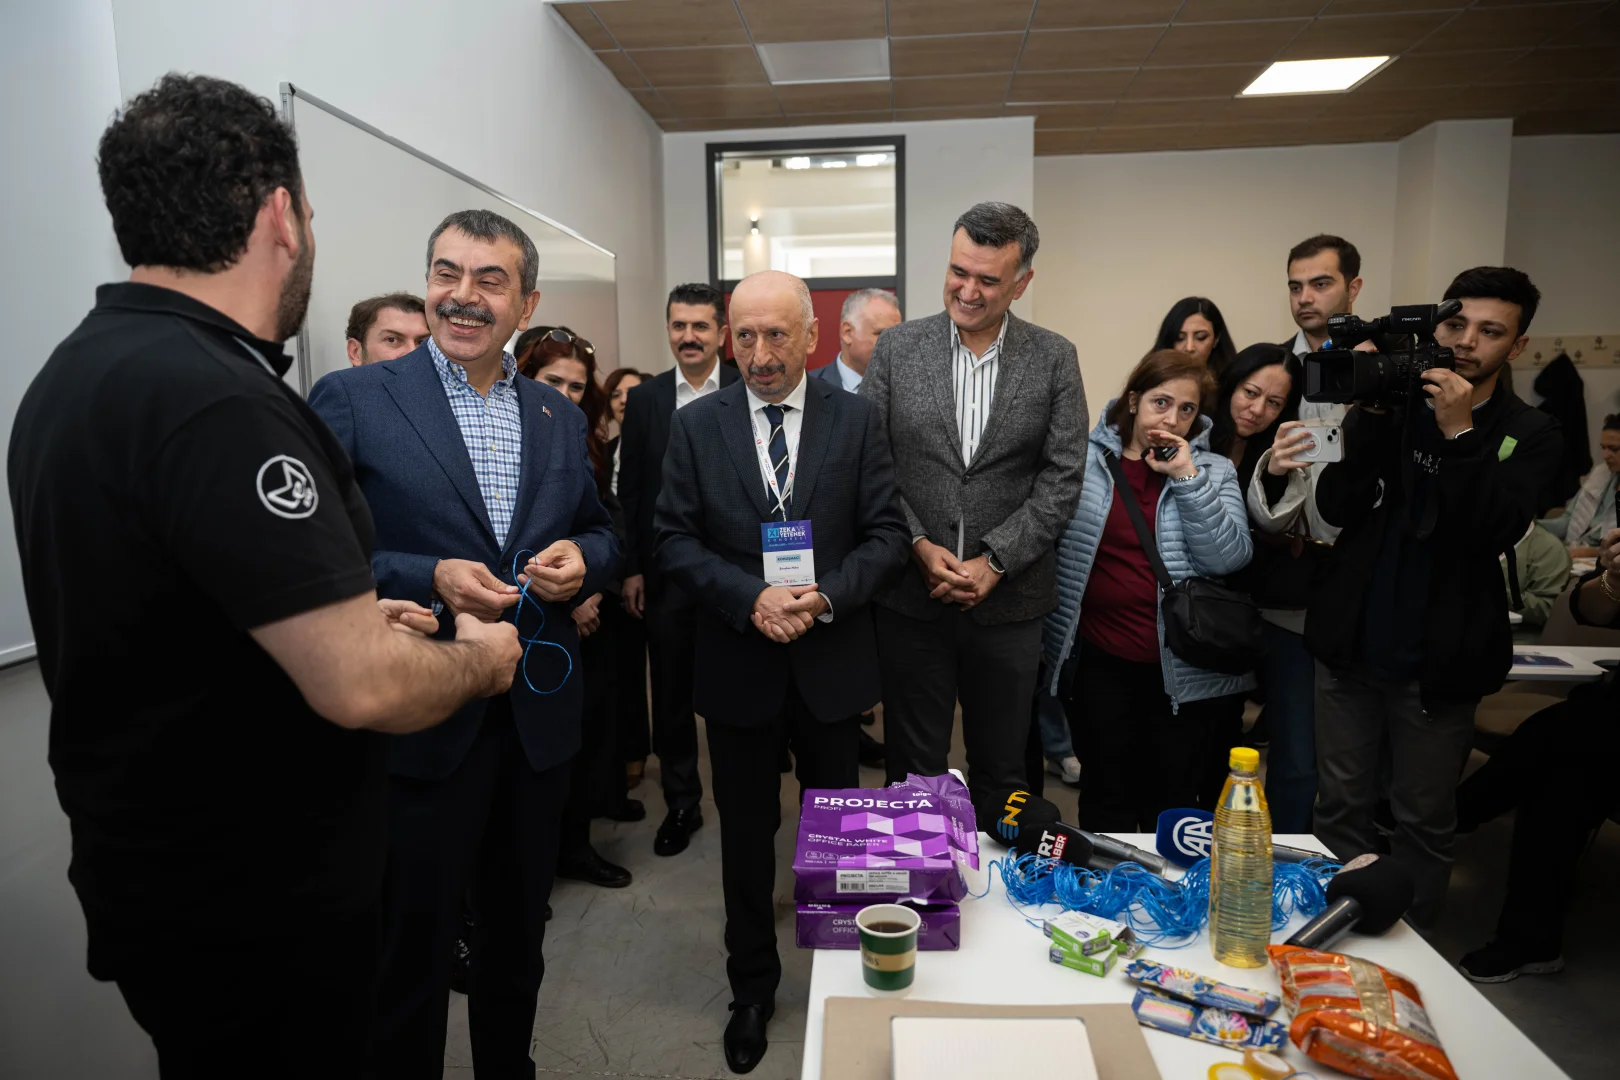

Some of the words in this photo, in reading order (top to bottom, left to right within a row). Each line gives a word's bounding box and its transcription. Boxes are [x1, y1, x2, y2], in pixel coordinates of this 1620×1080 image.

[814, 796, 933, 809] PROJECTA
[807, 838, 843, 846] OFFICE
[808, 833, 850, 843] CRYSTAL
